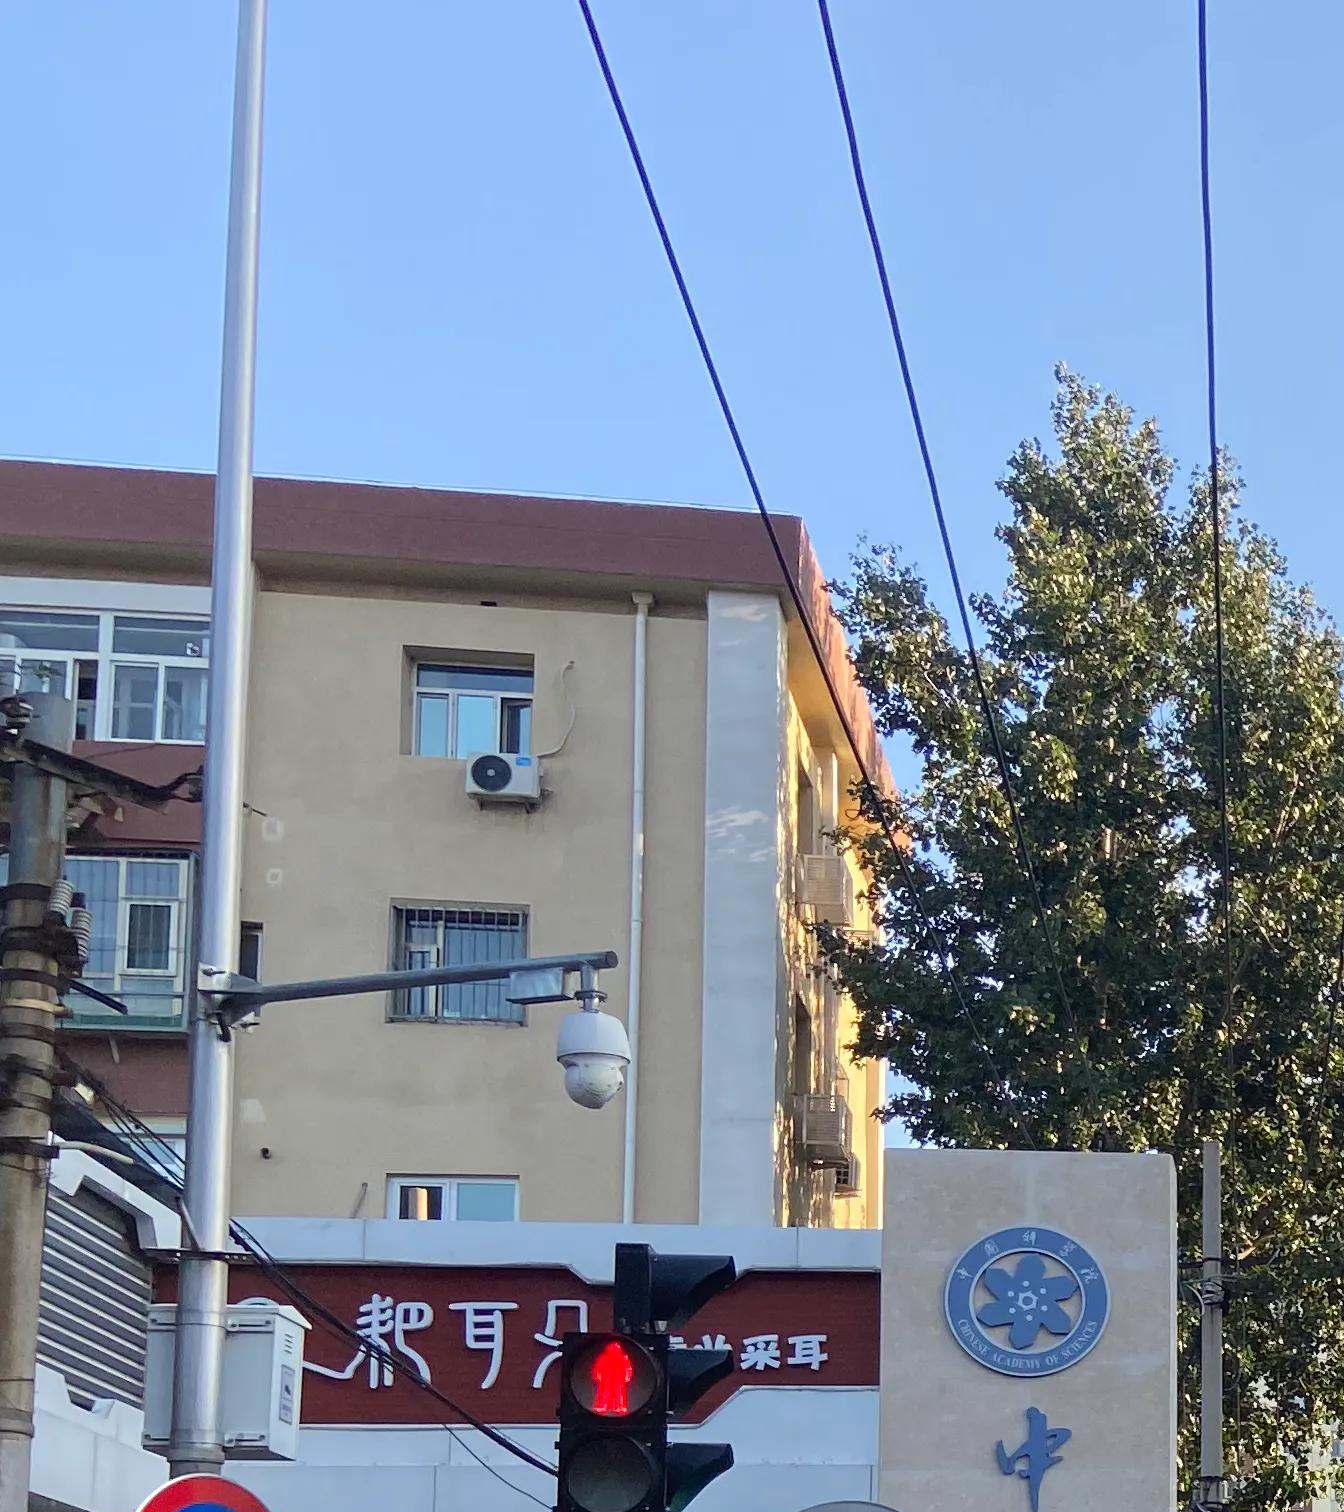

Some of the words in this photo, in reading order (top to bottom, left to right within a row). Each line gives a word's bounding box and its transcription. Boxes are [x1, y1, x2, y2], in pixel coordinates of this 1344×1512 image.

[957, 1319, 990, 1357] CHINESE
[992, 1353, 1041, 1369] ACADEMY
[1045, 1354, 1060, 1366] OF
[1062, 1320, 1098, 1360] SCIENCES
